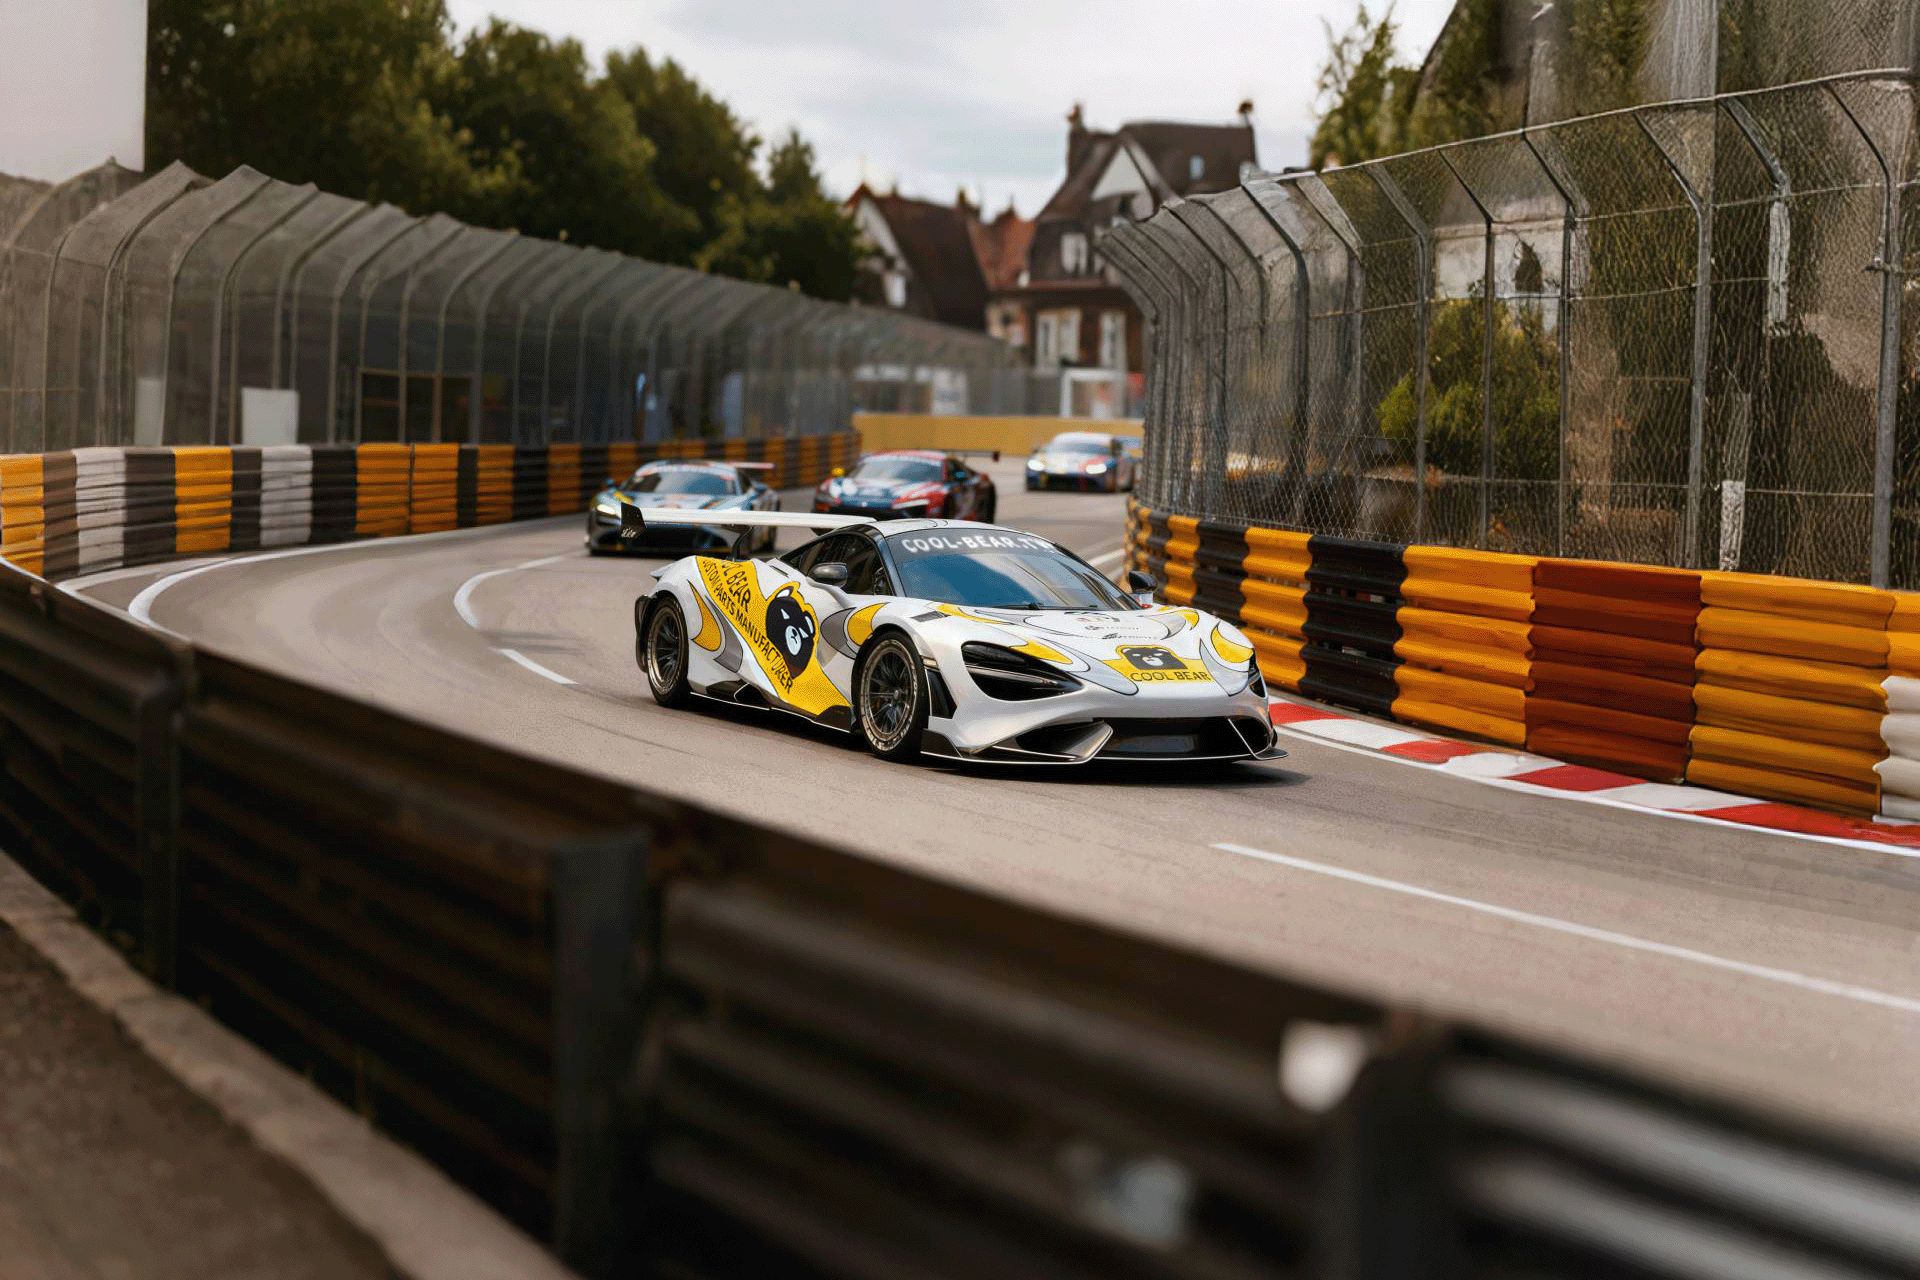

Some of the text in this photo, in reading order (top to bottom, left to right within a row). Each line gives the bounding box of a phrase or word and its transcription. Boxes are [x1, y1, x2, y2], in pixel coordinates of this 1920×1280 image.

[726, 571, 751, 613] BEAR
[702, 560, 721, 588] USTOM
[713, 583, 736, 616] PARTS
[735, 608, 793, 694] MANUFACTURER
[1130, 671, 1212, 682] COOL BEAR
